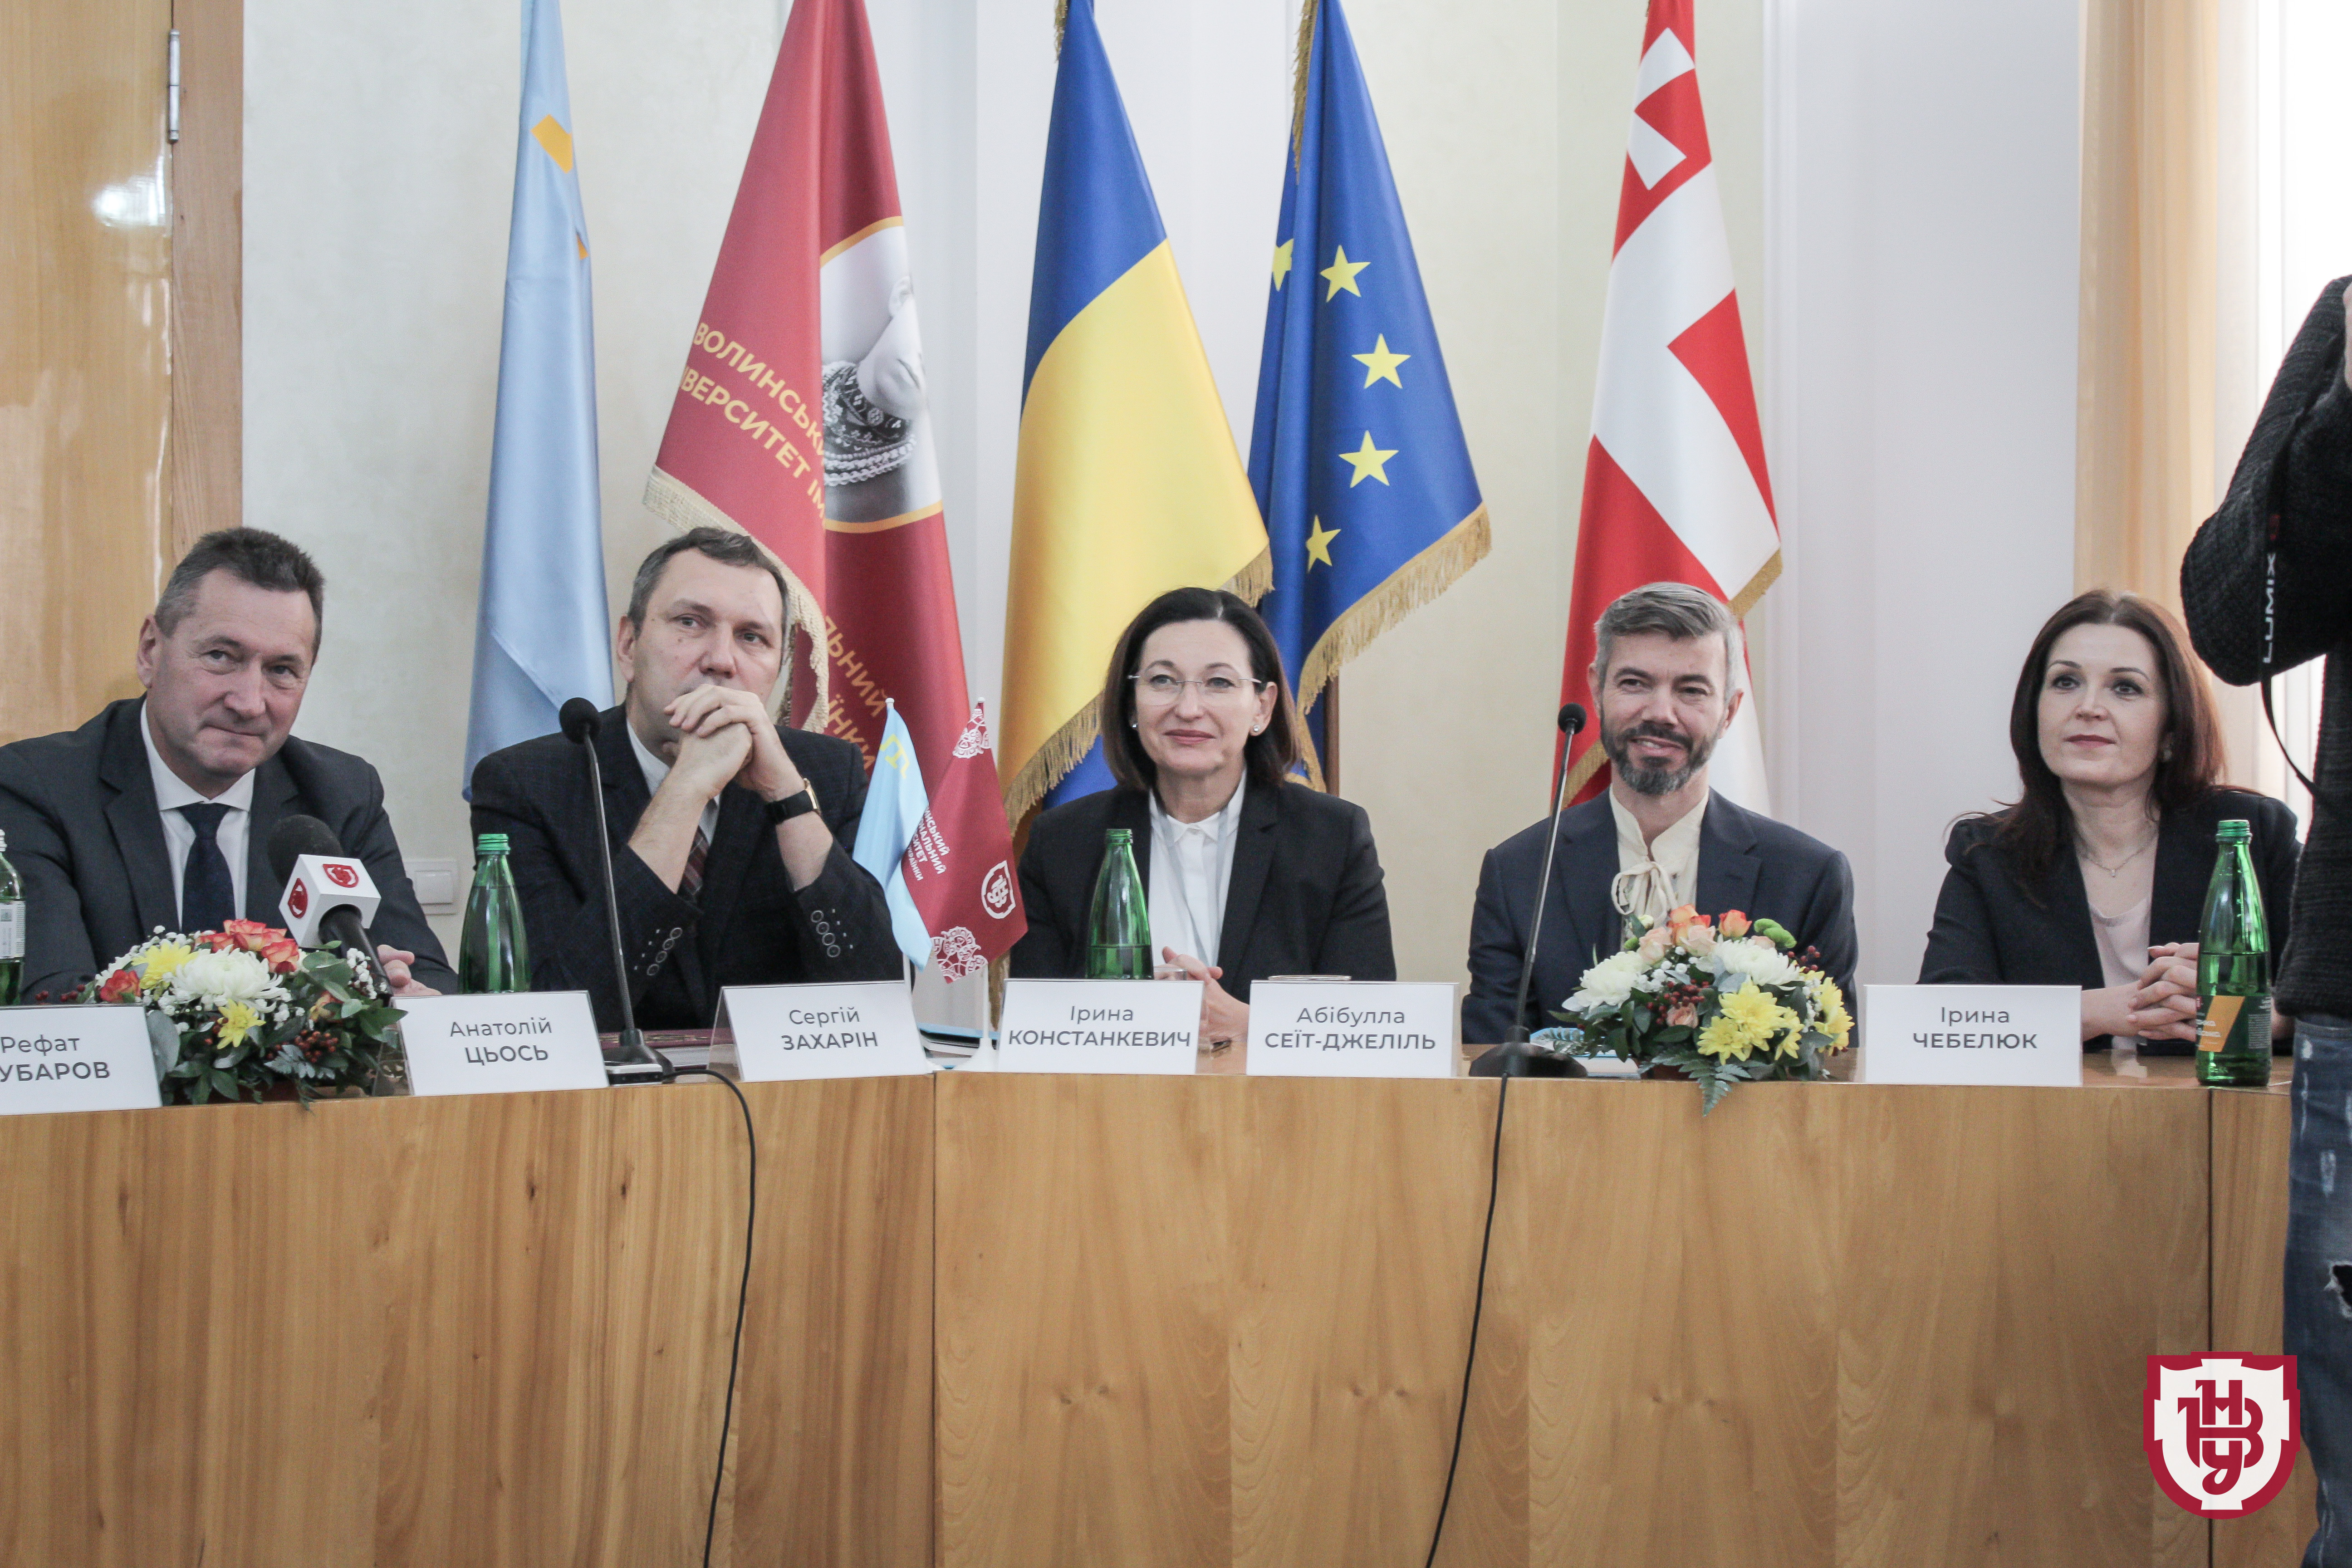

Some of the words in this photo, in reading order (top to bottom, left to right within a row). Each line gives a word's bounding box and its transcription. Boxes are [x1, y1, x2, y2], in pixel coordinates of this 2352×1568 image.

[681, 366, 811, 478] ВЕРСИТЕТ
[2263, 552, 2277, 663] LUMIX
[912, 830, 928, 862] СИТЕТ
[789, 1006, 860, 1028] Сергій
[1071, 1006, 1133, 1024] Ірина
[1296, 1006, 1405, 1028] Абібулла
[1941, 1007, 2009, 1027] Ірина
[450, 1017, 552, 1037] Анатолій
[0, 1034, 80, 1056] Рефат
[781, 1032, 878, 1050] ЗАХАРІН
[1009, 1030, 1191, 1047] КОНСТАНКЕВИЧ
[1265, 1029, 1436, 1051] СЕЇТ-ДЖЕЛІЛЬ
[1913, 1033, 2037, 1049] ЧЕБЕЛЮК
[465, 1045, 549, 1066] ЦЬОСЬ
[0, 1061, 110, 1083] УБАРОВ
